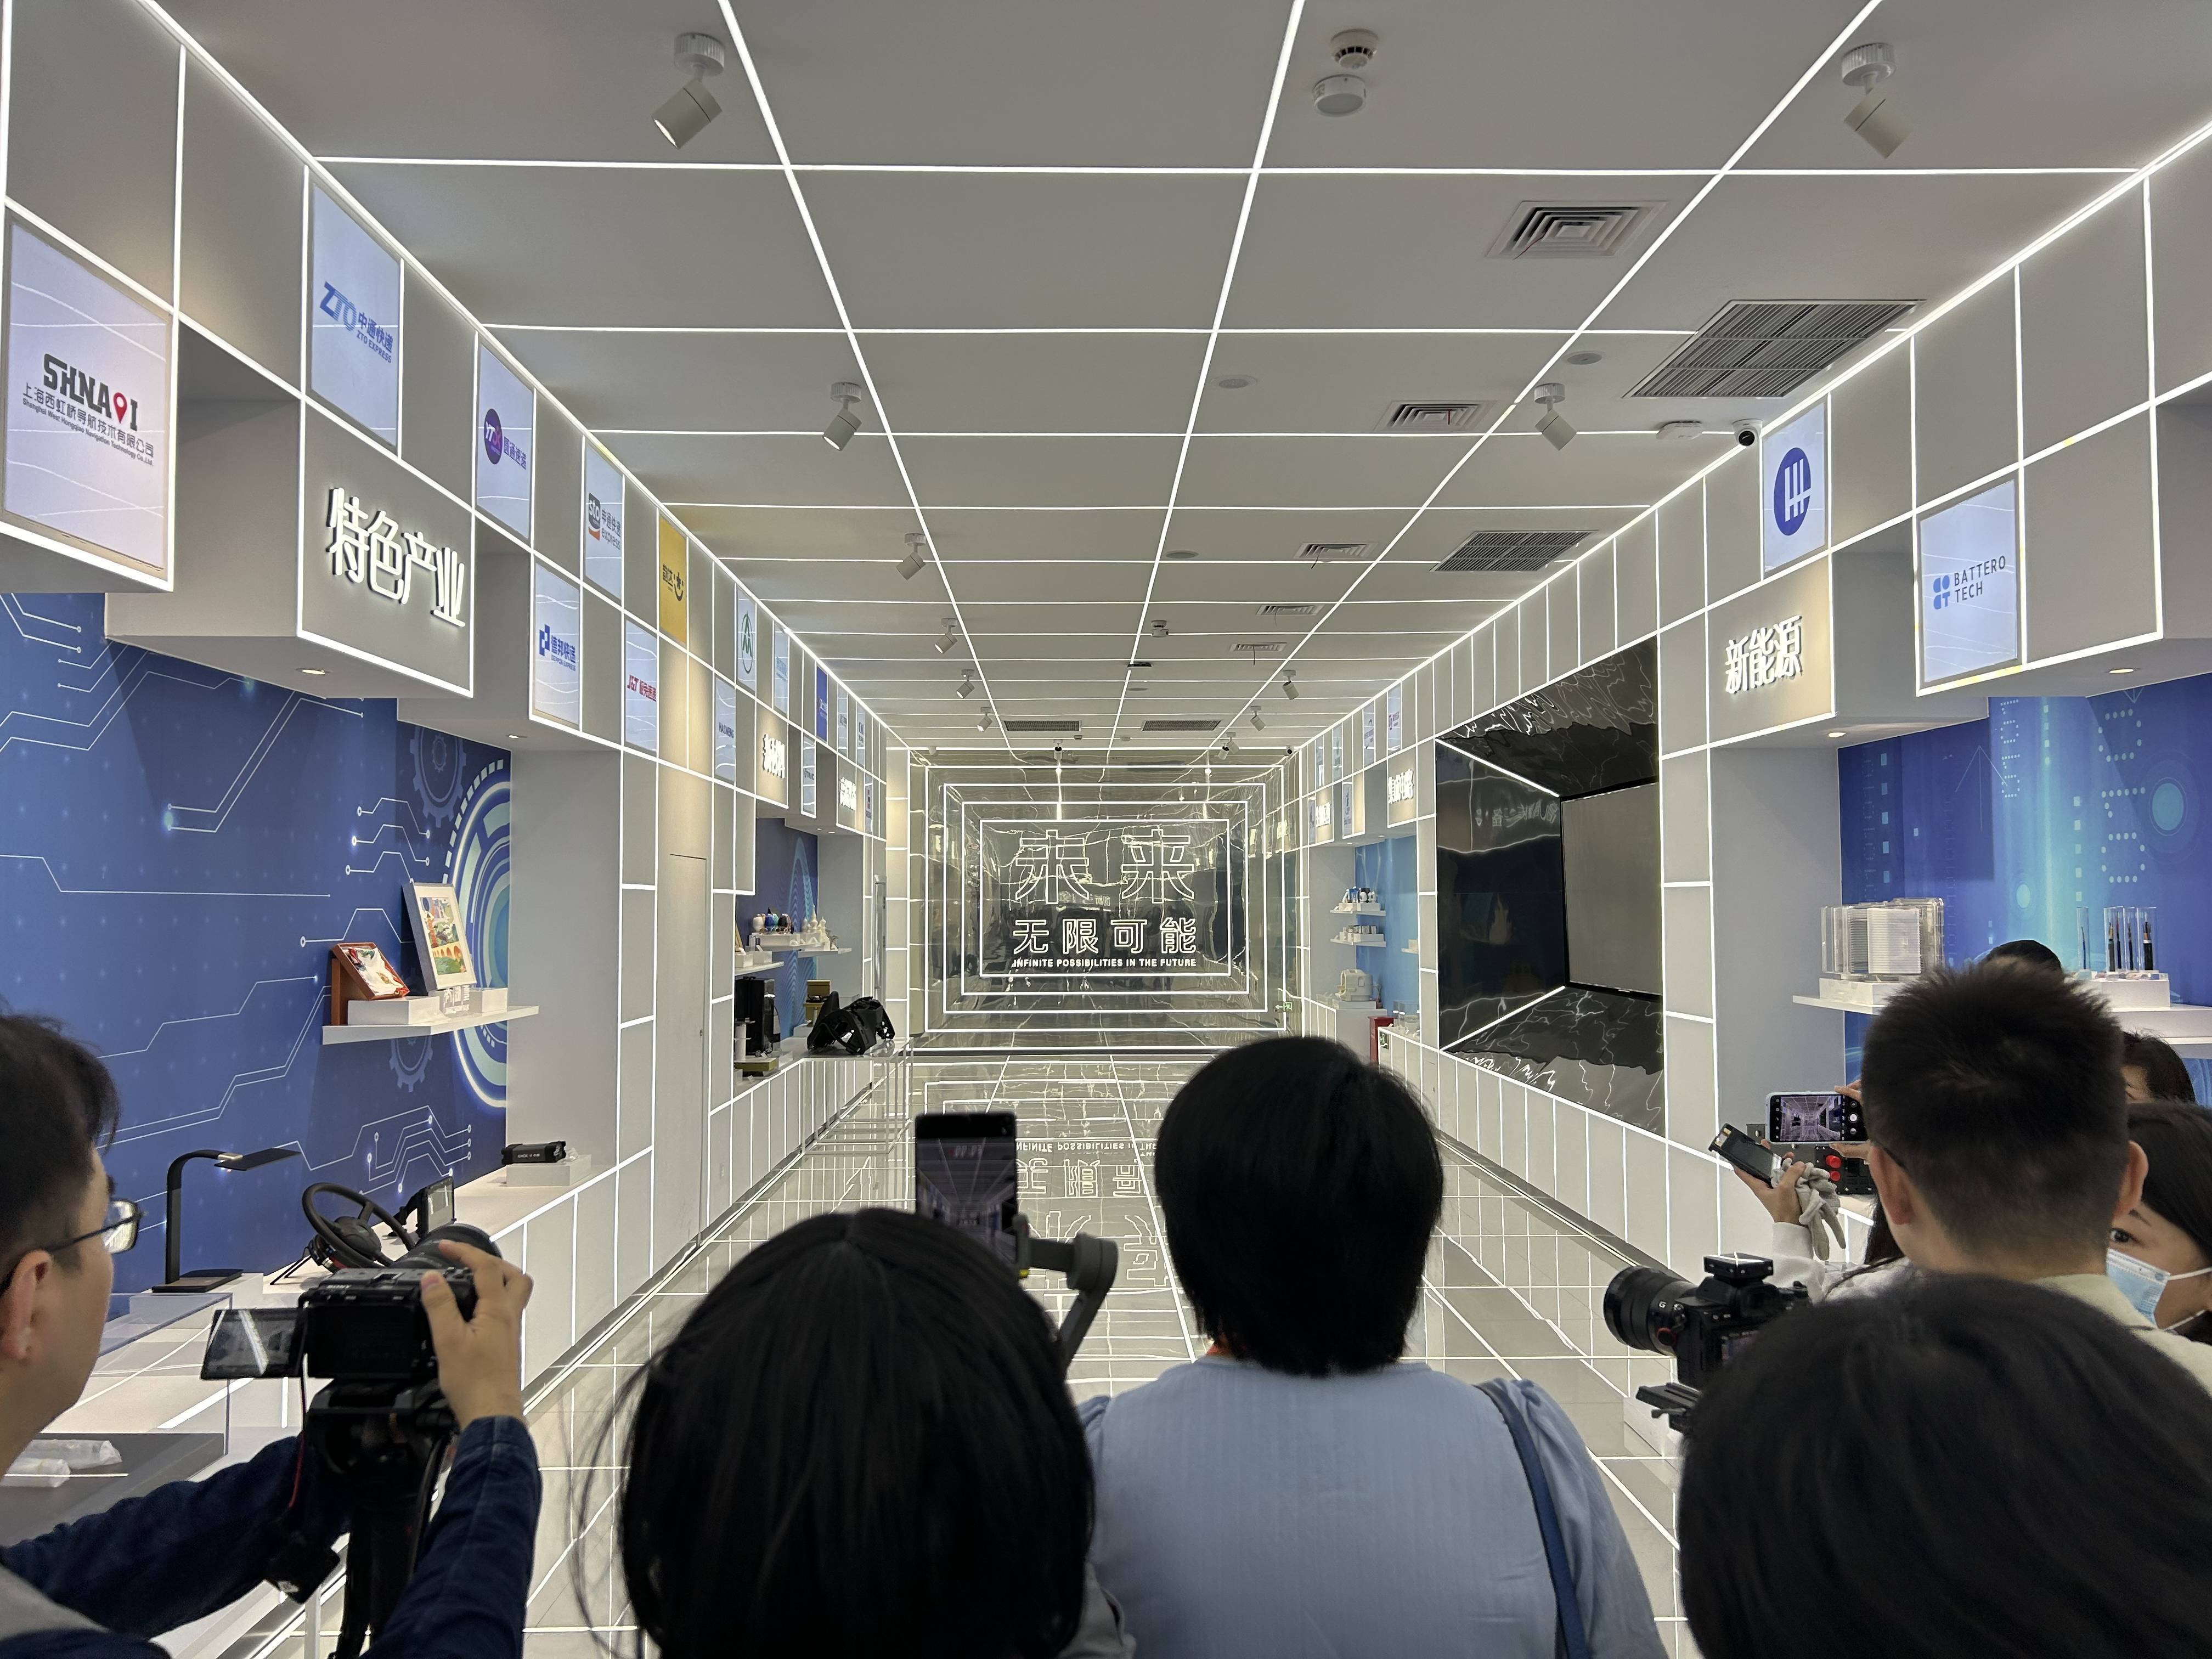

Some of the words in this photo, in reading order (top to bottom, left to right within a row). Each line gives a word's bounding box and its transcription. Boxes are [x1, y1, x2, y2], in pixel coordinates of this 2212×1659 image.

[357, 330, 368, 344] ZTO
[369, 339, 392, 363] EXPRESS
[358, 312, 393, 353] 中通快递
[23, 398, 47, 415] Shanghai
[48, 409, 60, 422] West
[589, 499, 600, 521] sto
[601, 528, 620, 550] express
[326, 488, 466, 627] 特色产业
[1954, 555, 2006, 586] BATTERO
[1955, 581, 1983, 602] TECH
[1725, 615, 1802, 694] 新能源
[1015, 828, 1195, 905] 未来
[1013, 917, 1197, 955] 无限可能
[1014, 958, 1053, 967] INFINITE
[1057, 958, 1123, 967] POSSIBILITIES
[1126, 958, 1136, 967] IN
[1139, 958, 1157, 967] THE
[1160, 958, 1197, 967] FUTURE
